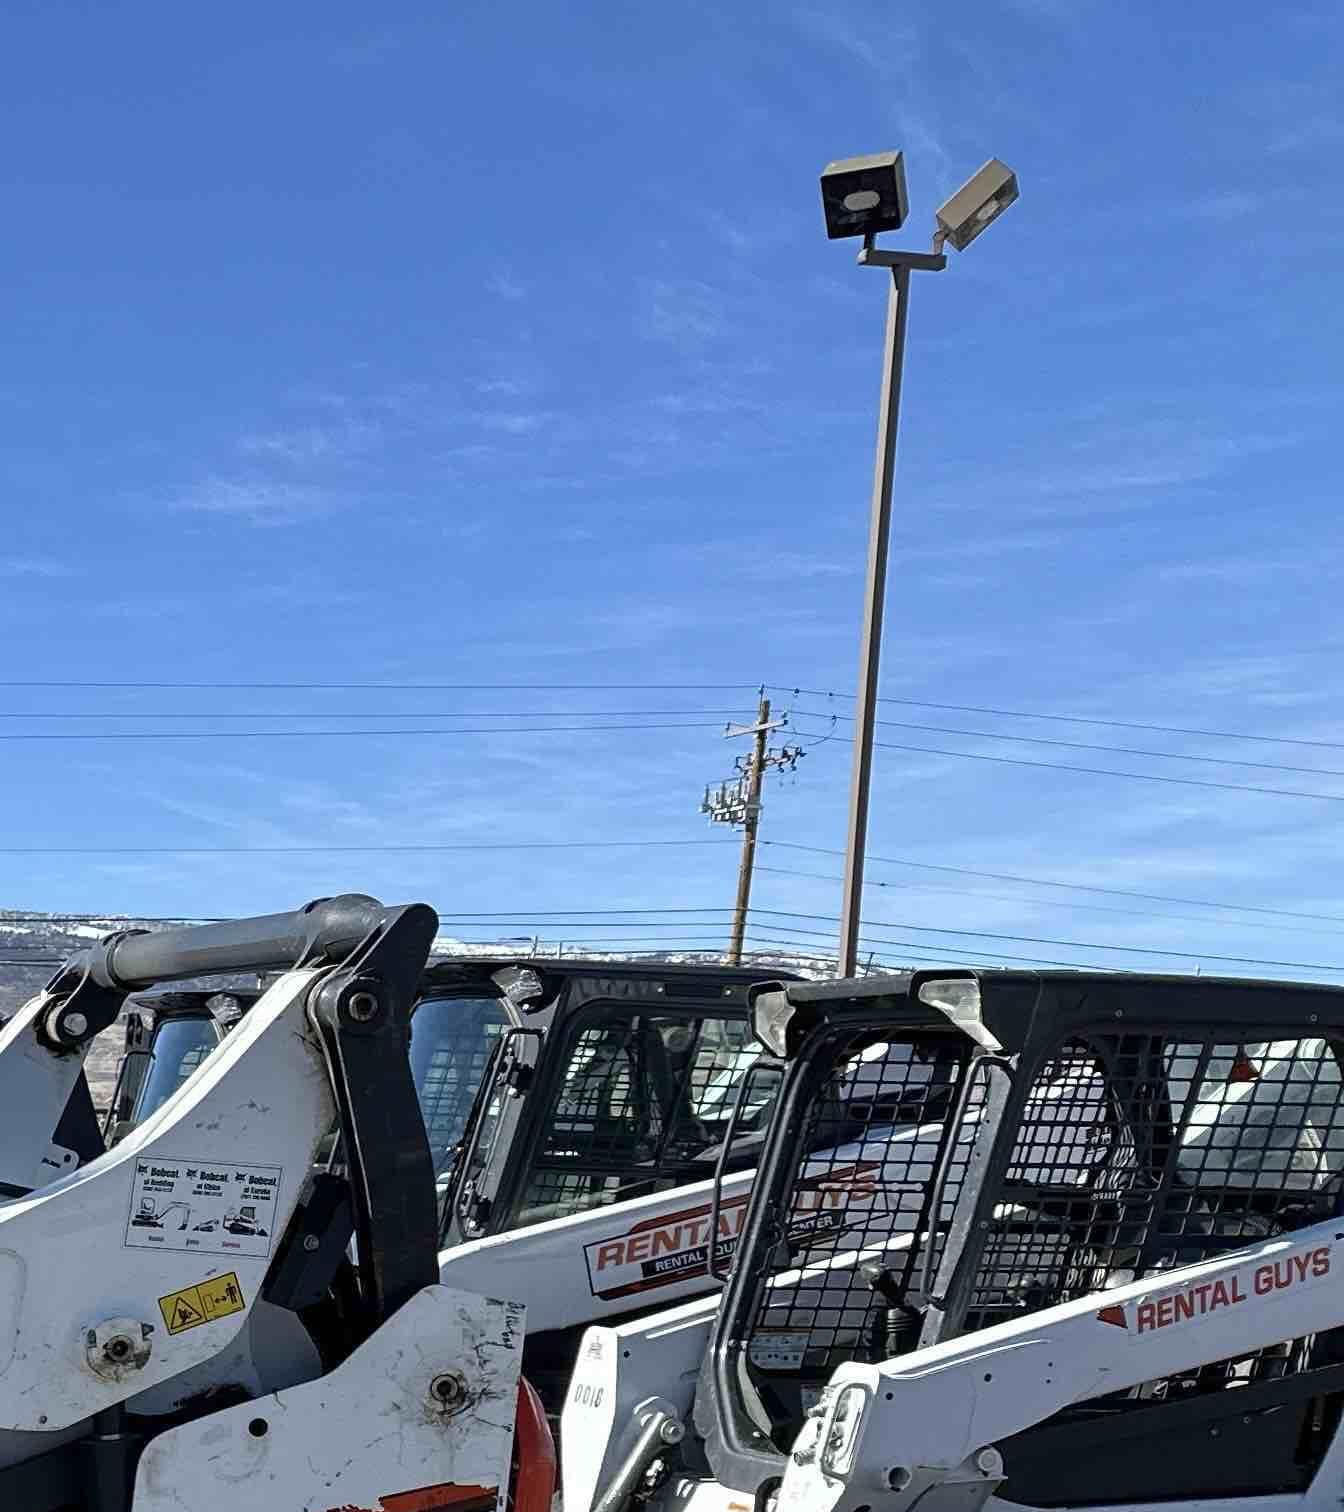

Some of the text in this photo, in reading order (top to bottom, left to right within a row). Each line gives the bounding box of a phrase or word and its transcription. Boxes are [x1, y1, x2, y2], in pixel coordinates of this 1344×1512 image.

[656, 1251, 704, 1272] RENTAL
[1137, 1247, 1330, 1334] RENTAL GUYS
